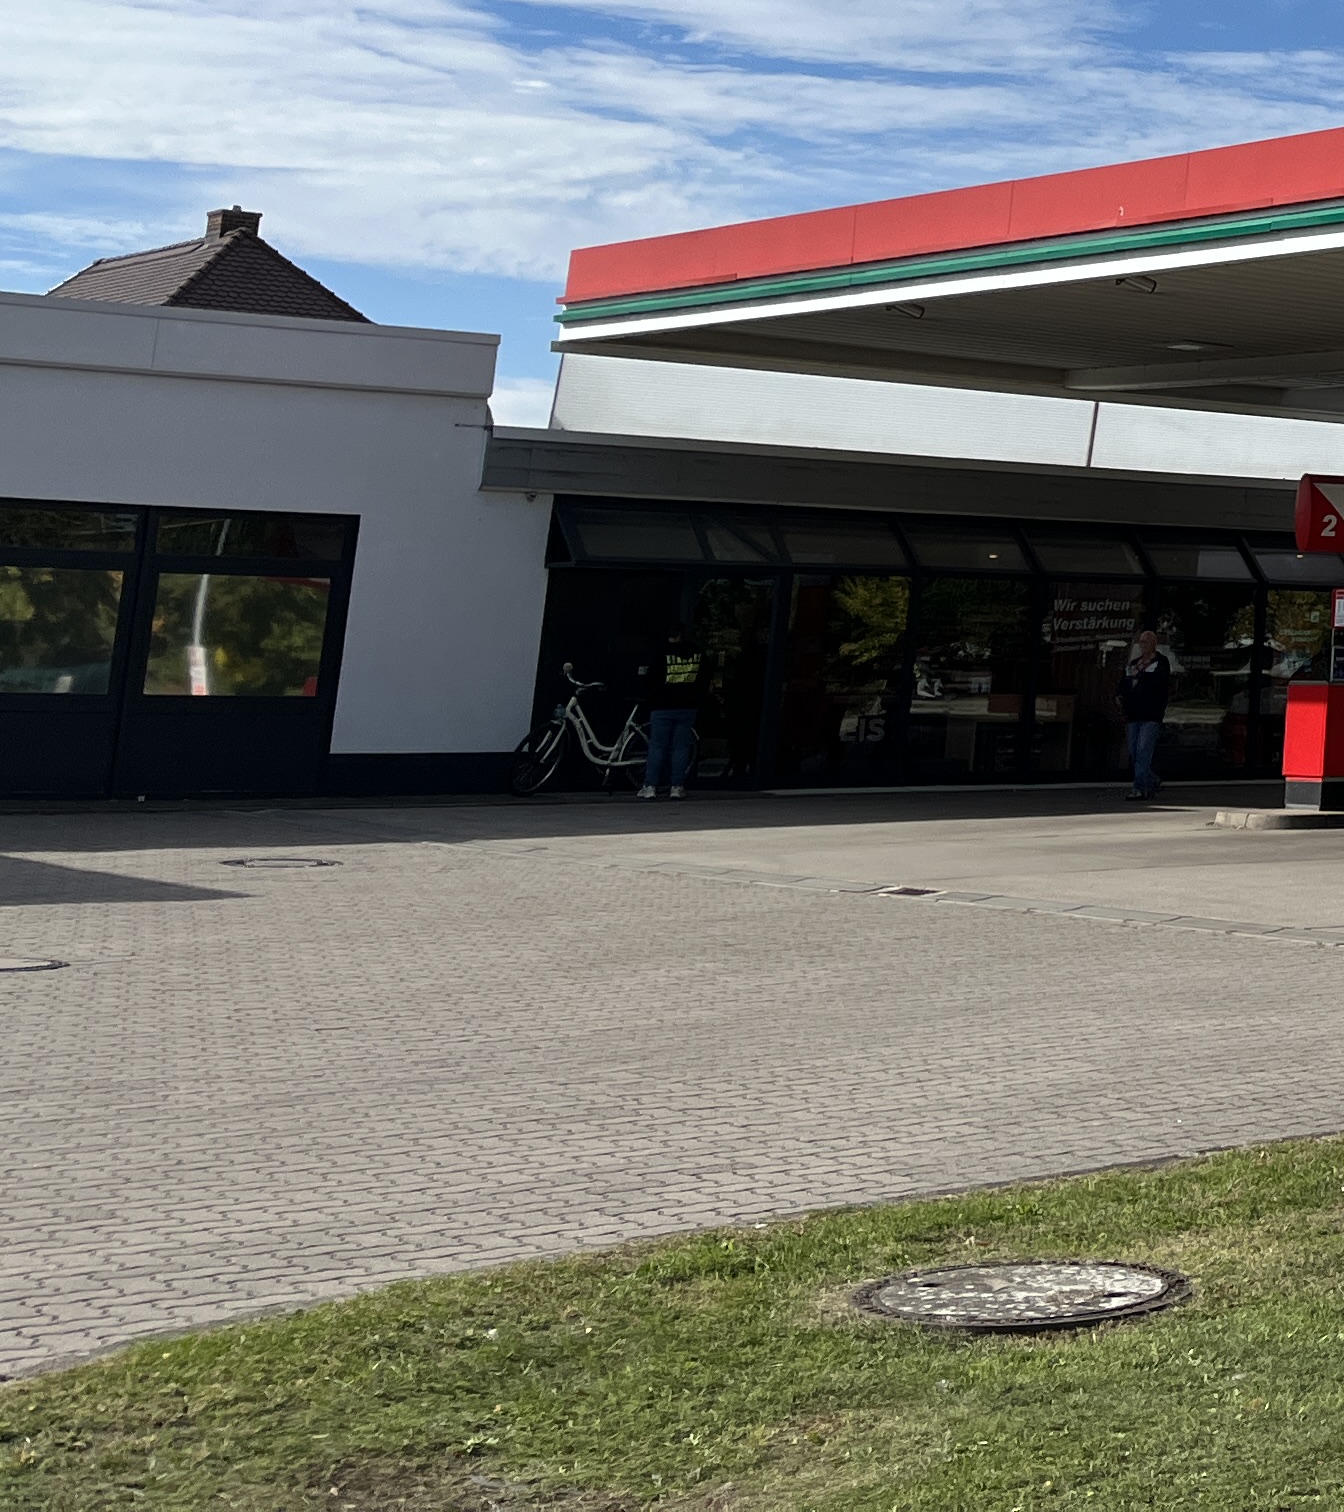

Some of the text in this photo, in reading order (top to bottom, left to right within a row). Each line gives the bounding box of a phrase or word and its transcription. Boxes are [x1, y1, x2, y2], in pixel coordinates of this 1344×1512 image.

[1321, 515, 1338, 537] 2
[1054, 598, 1130, 611] Wir suchen
[1053, 615, 1135, 631] Verstärkung
